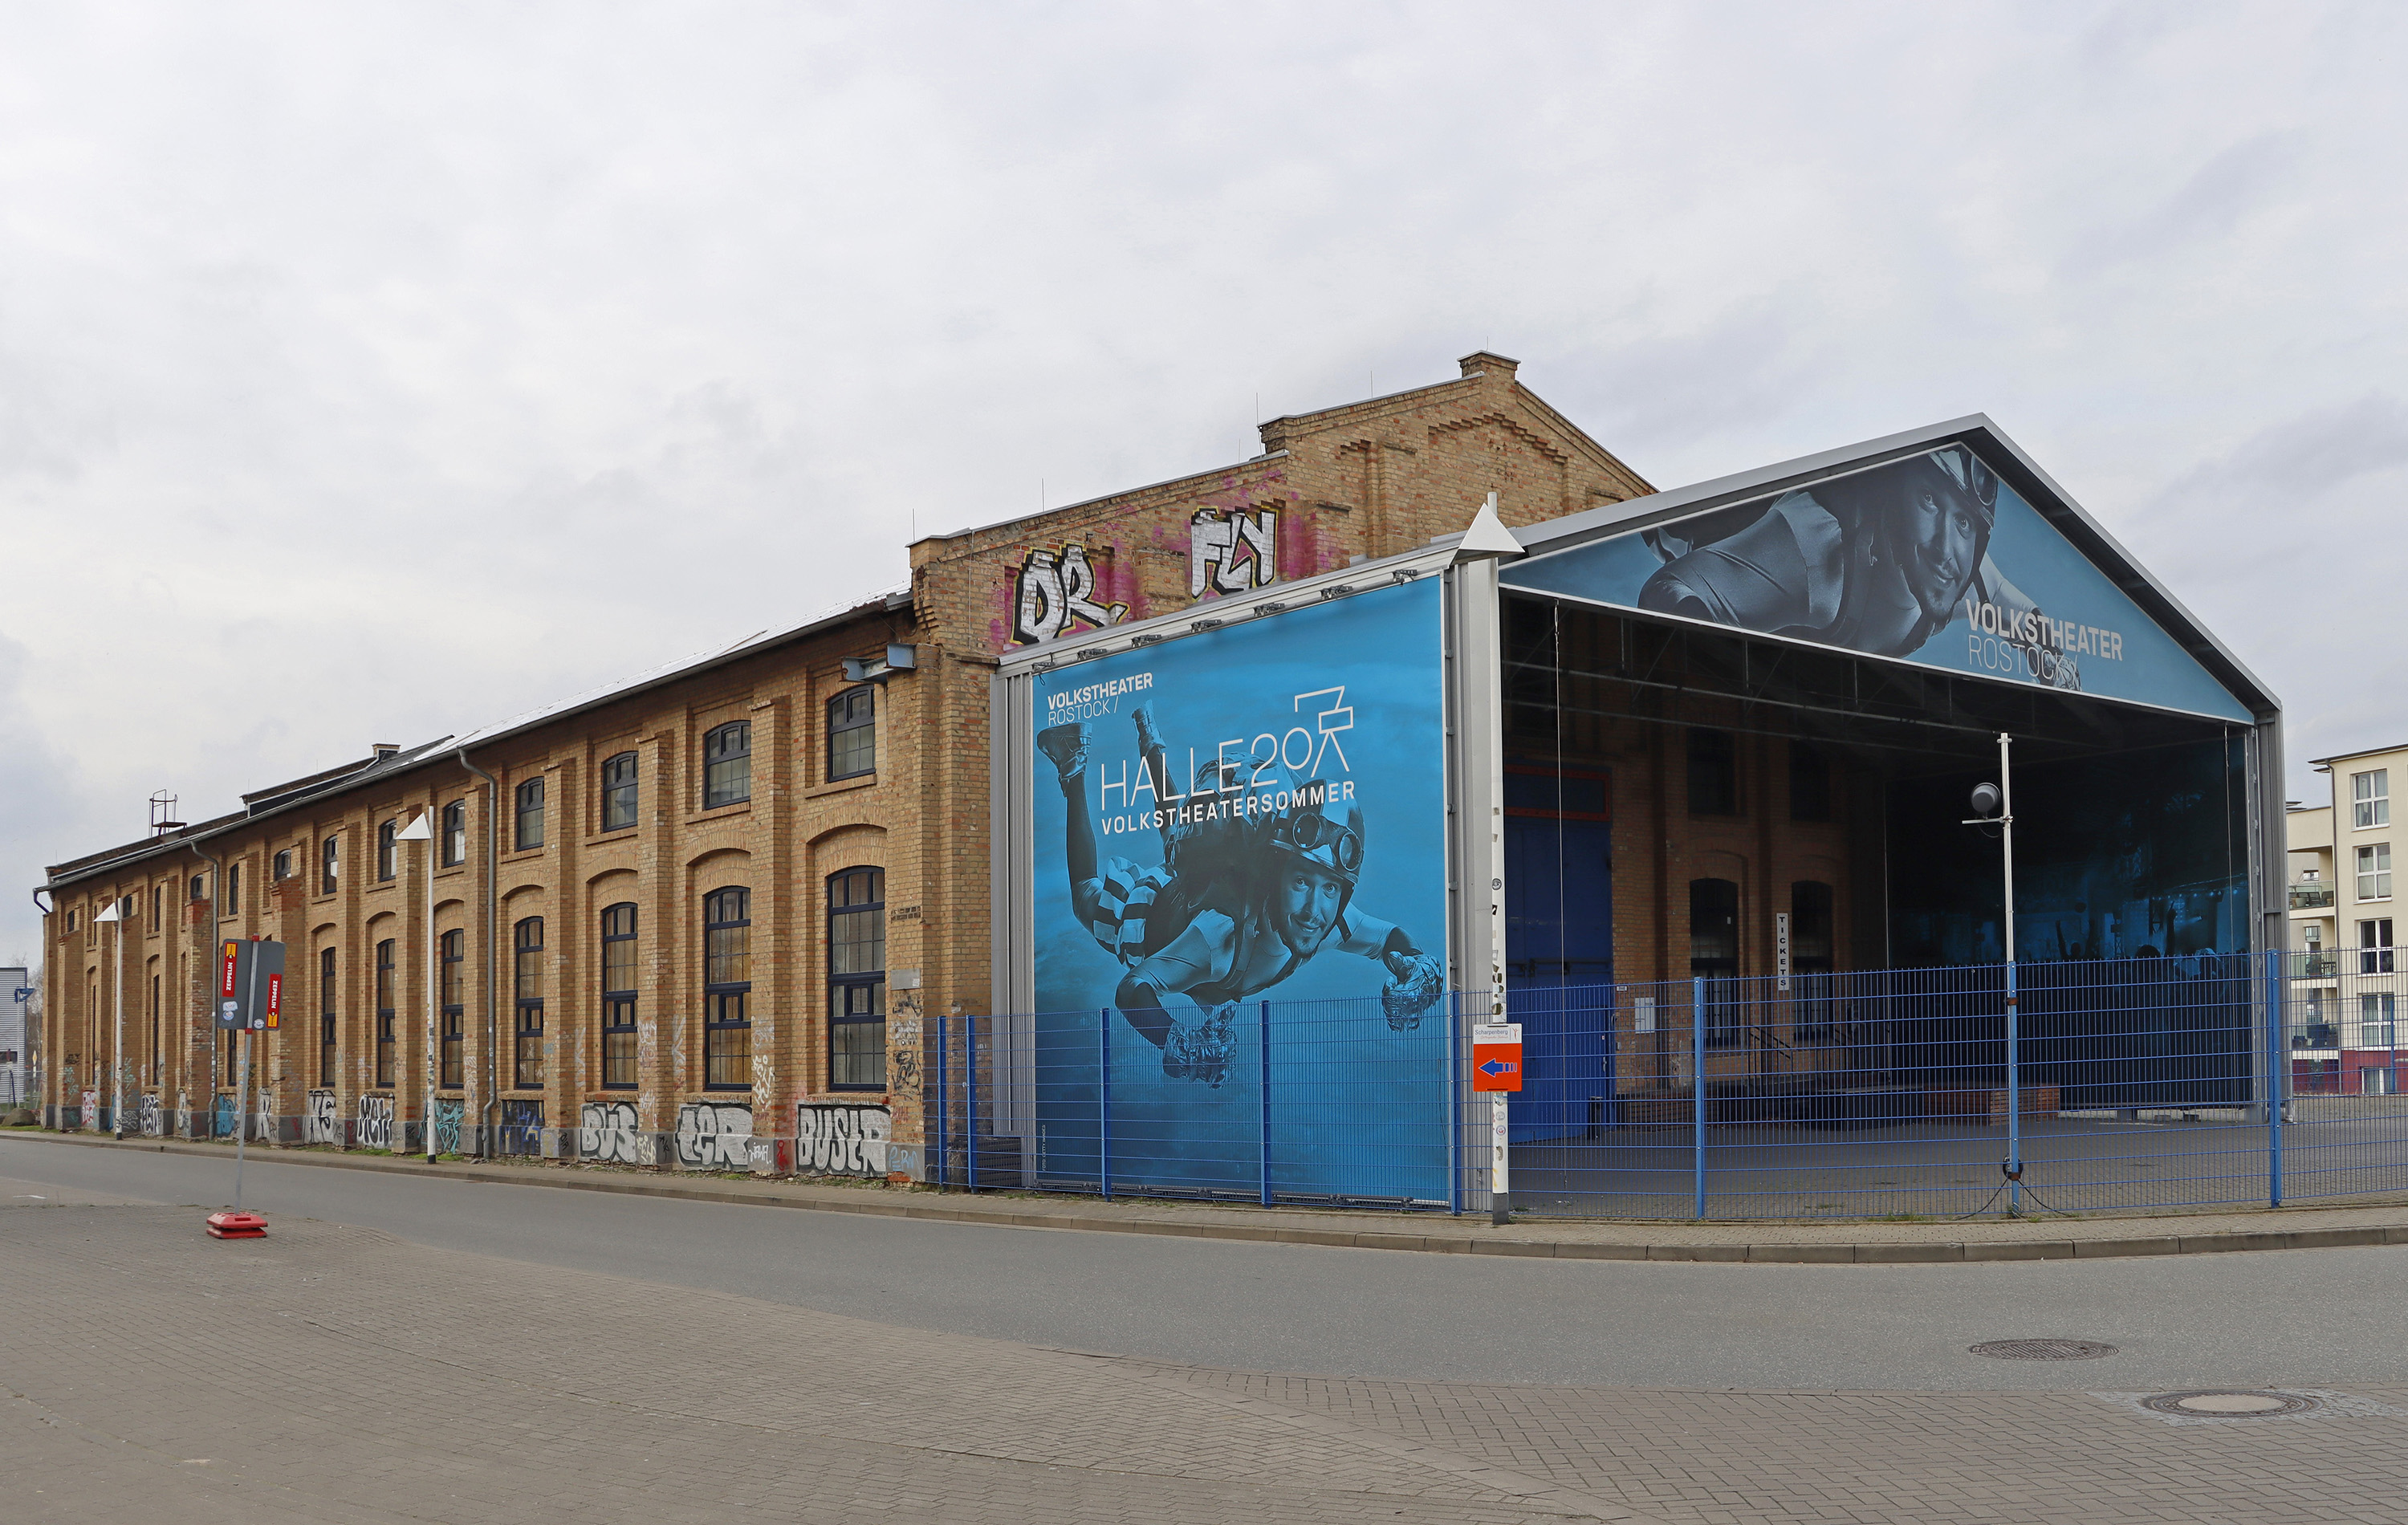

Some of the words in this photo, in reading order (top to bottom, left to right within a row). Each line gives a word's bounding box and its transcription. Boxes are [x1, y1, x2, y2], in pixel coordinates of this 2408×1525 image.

[1191, 507, 1278, 600] FLY
[1966, 599, 2123, 661] VOLKSTHEATER
[1969, 634, 2065, 681] ROSTOCK
[1047, 672, 1153, 710] VOLKSTHEATER
[1048, 698, 1110, 726] ROSTOCK
[1101, 781, 1355, 835] VOLKSTHEATERSOMMER
